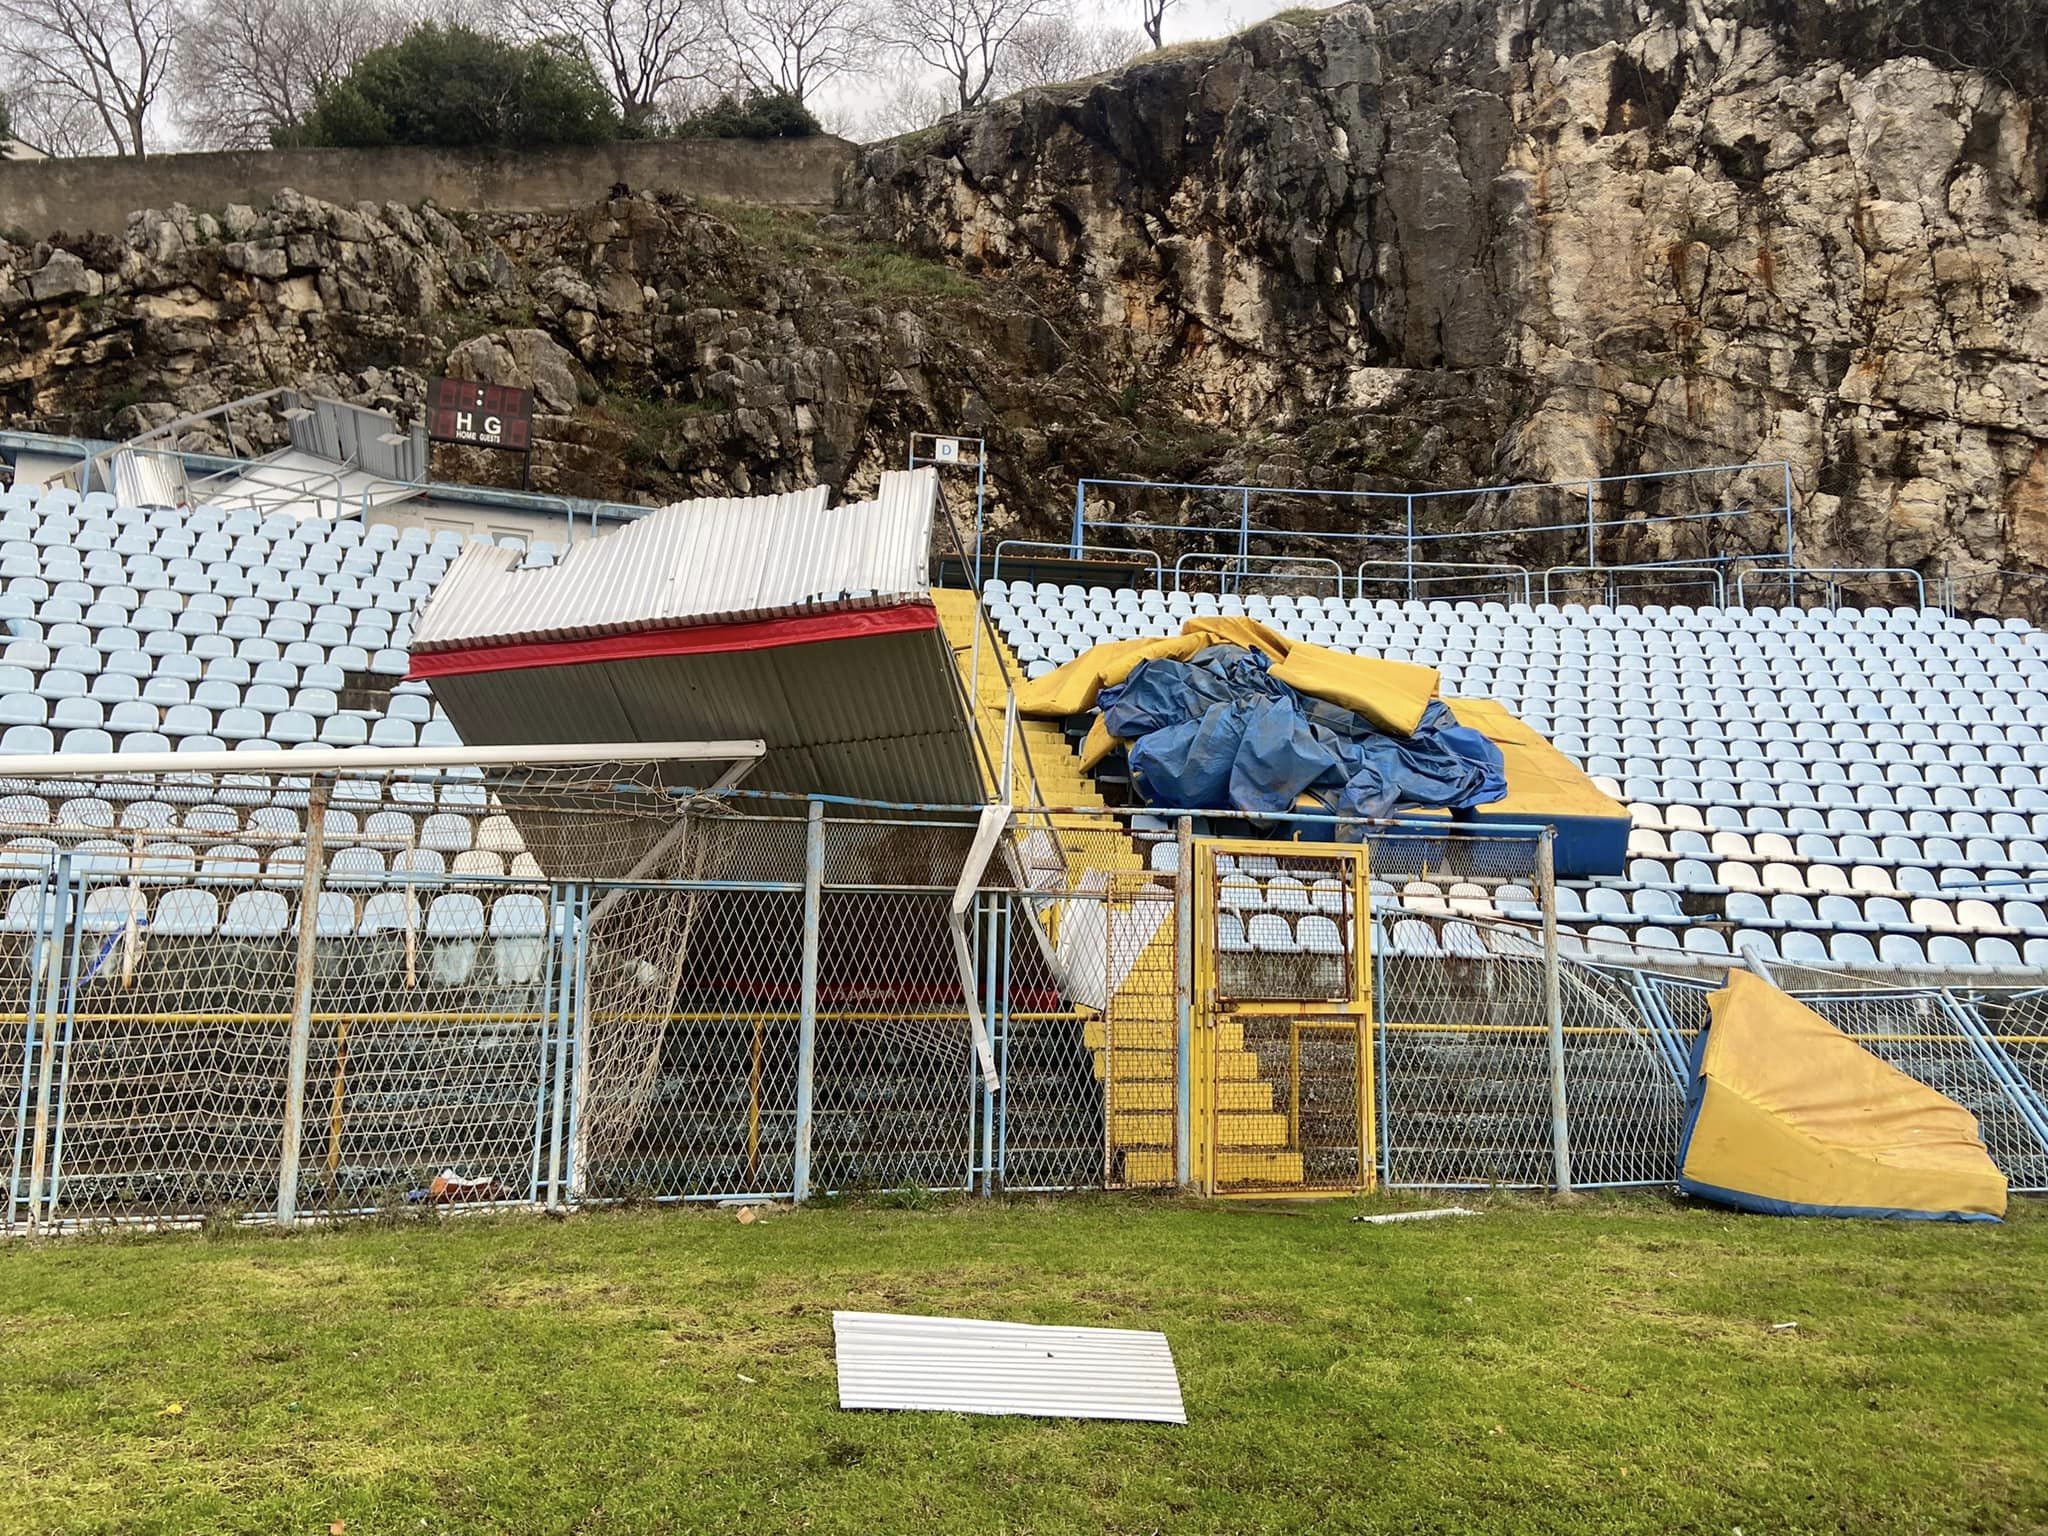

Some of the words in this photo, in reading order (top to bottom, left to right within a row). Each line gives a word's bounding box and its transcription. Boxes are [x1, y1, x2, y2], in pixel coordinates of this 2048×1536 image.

[456, 412, 472, 431] H
[484, 416, 501, 434] G
[456, 431, 476, 440] HOME
[479, 433, 500, 443] GUESTS
[942, 445, 951, 455] D
